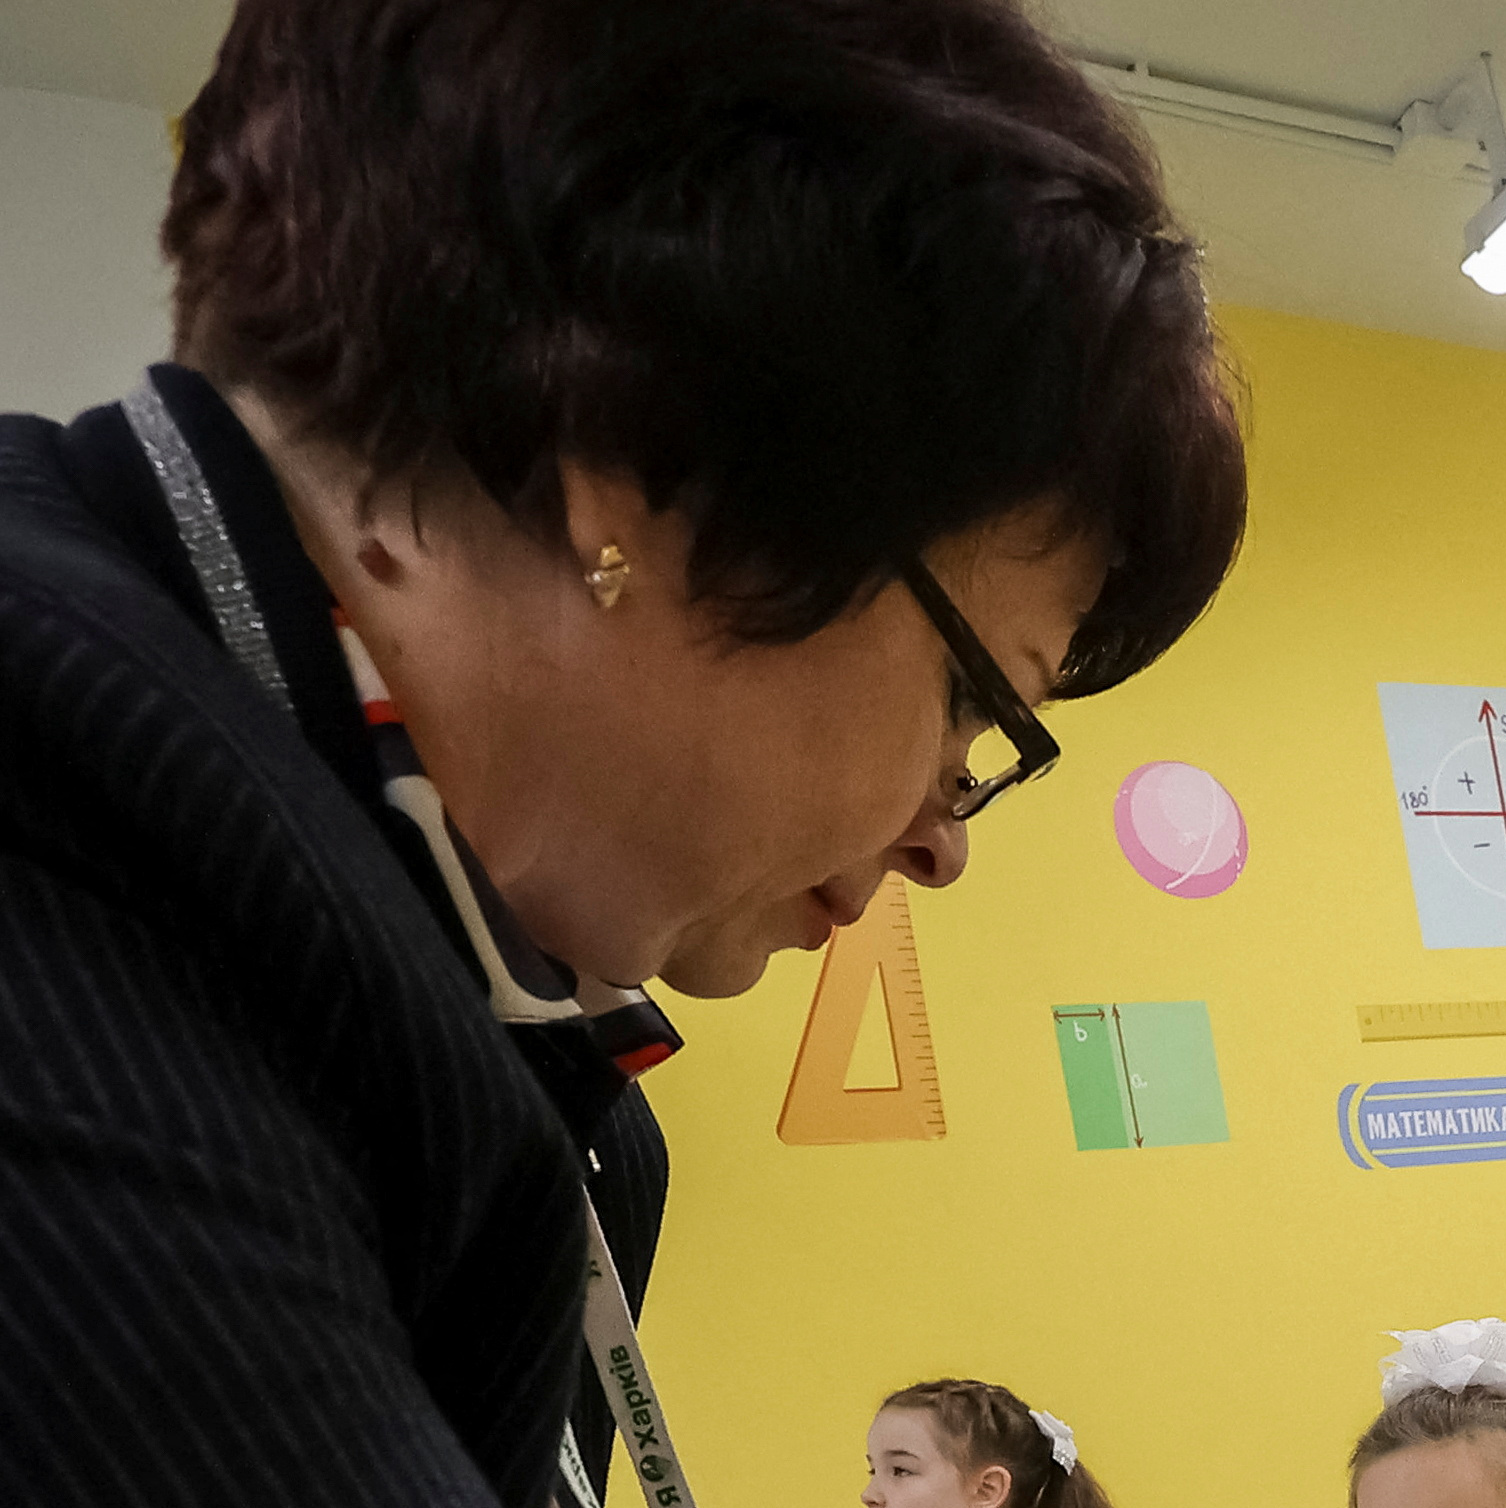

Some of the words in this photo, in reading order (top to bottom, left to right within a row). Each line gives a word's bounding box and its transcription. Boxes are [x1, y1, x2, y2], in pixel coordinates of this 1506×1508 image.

[1073, 1019, 1088, 1042] b
[609, 1344, 661, 1451] Харків
[655, 1485, 683, 1508] Я
